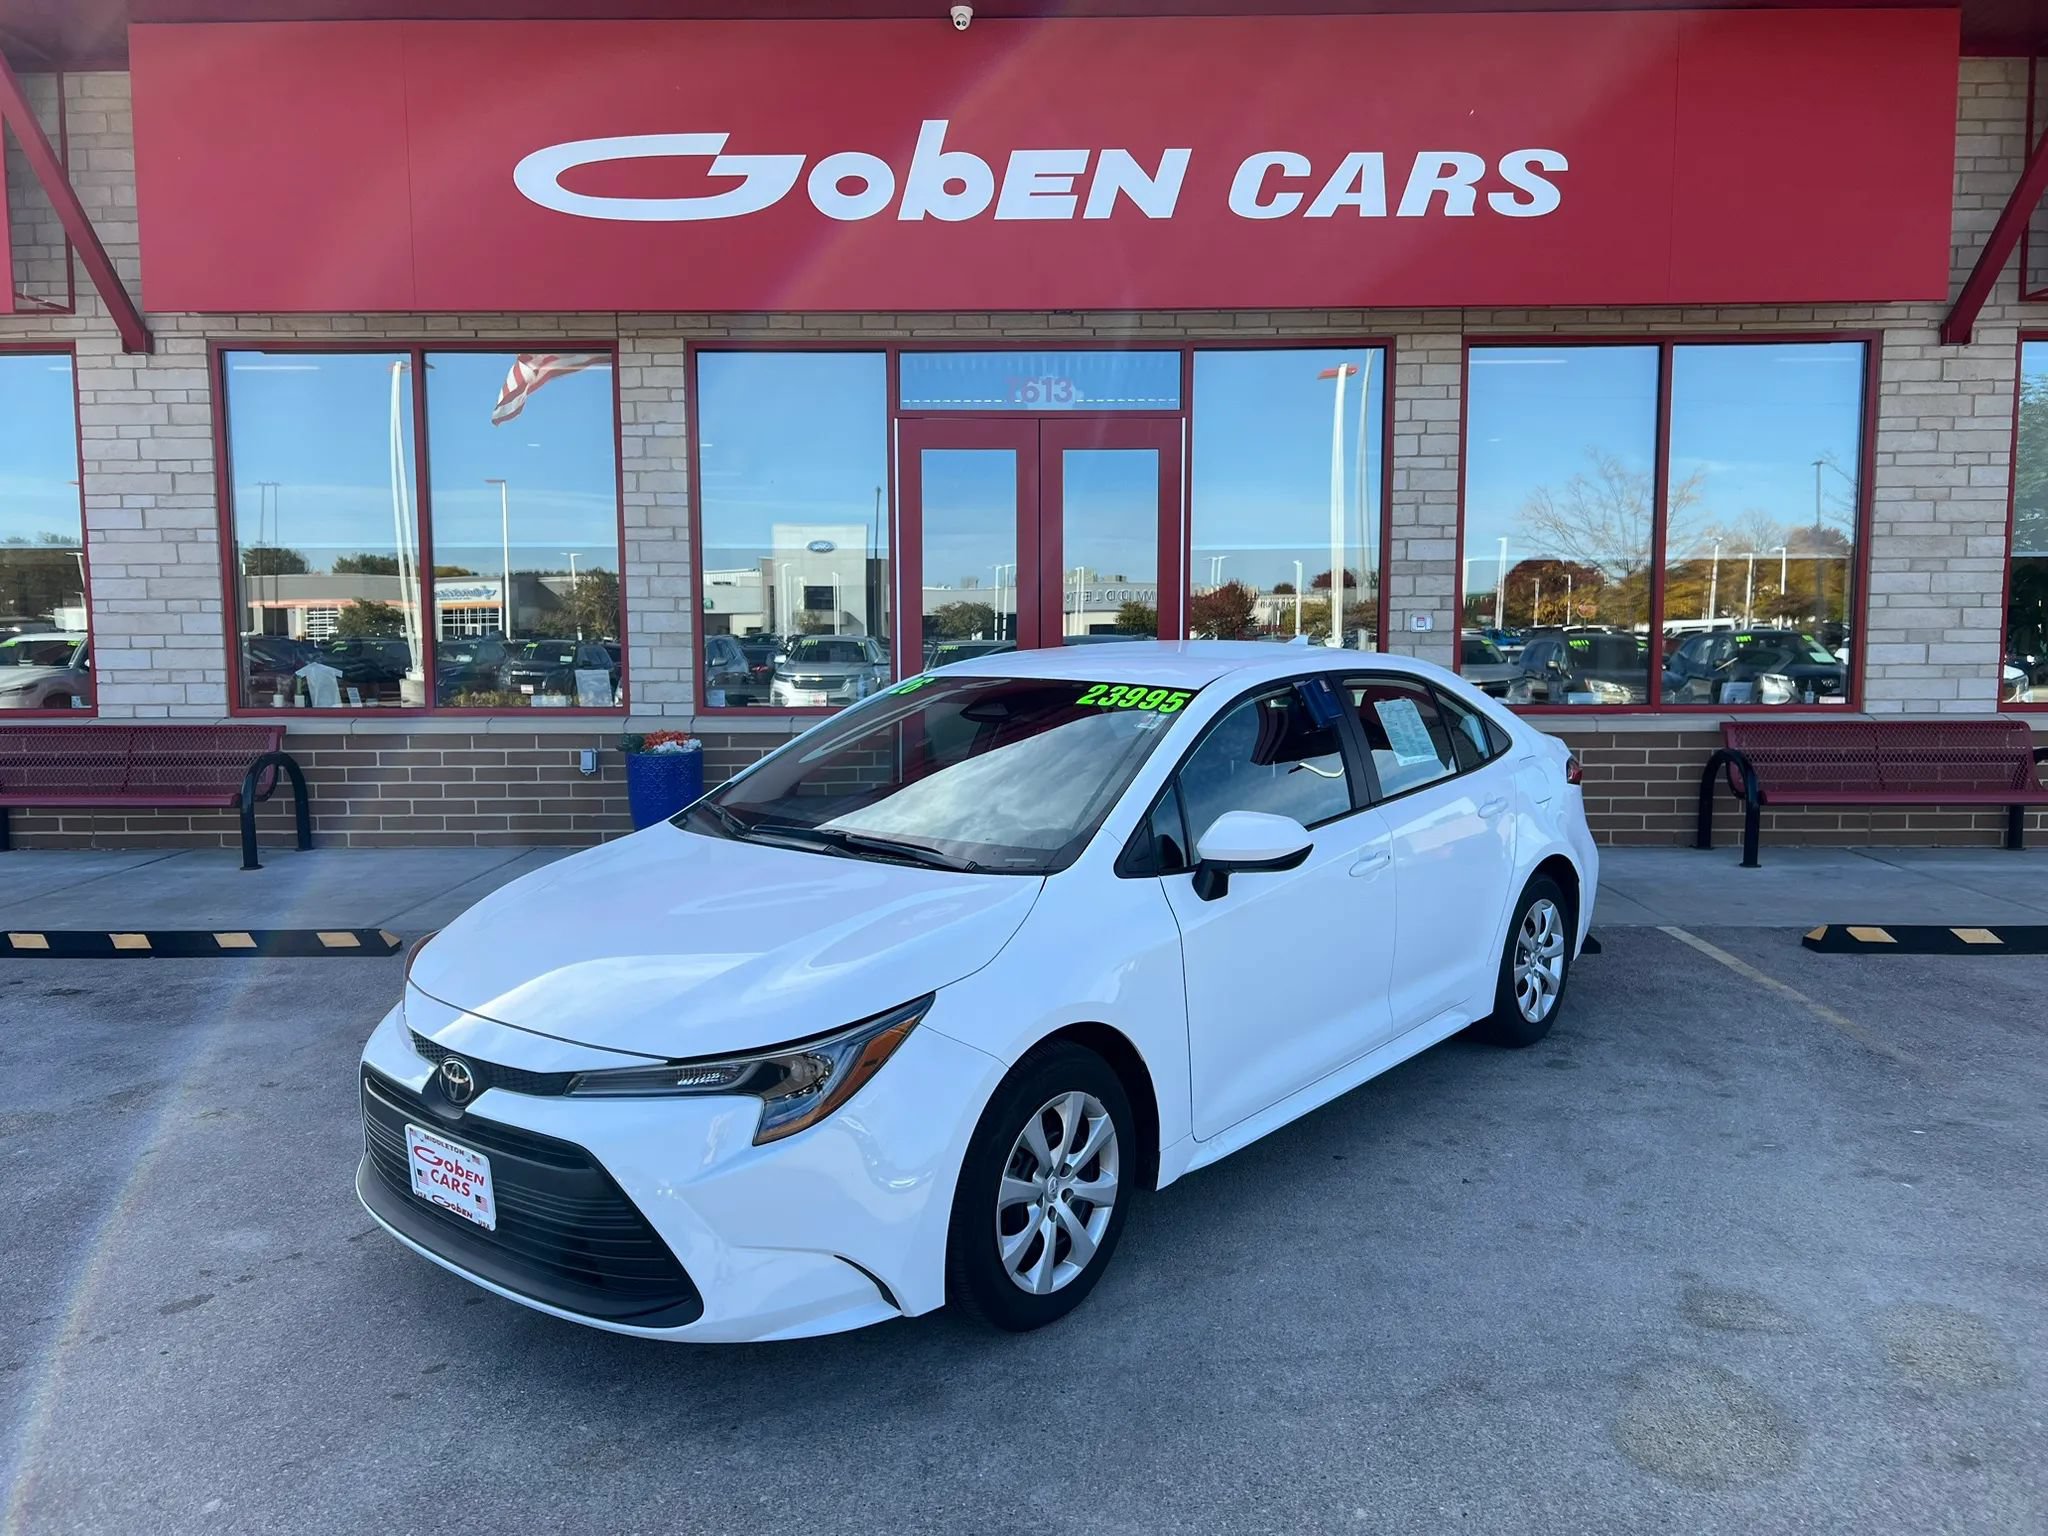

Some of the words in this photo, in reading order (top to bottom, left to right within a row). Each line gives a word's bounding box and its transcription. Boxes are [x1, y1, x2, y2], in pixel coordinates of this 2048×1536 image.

[1228, 148, 1568, 219] CARS
[1005, 377, 1073, 403] 7613
[1075, 684, 1192, 713] 23995
[424, 1134, 465, 1156] MIDDLETON
[430, 1169, 471, 1197] CARS
